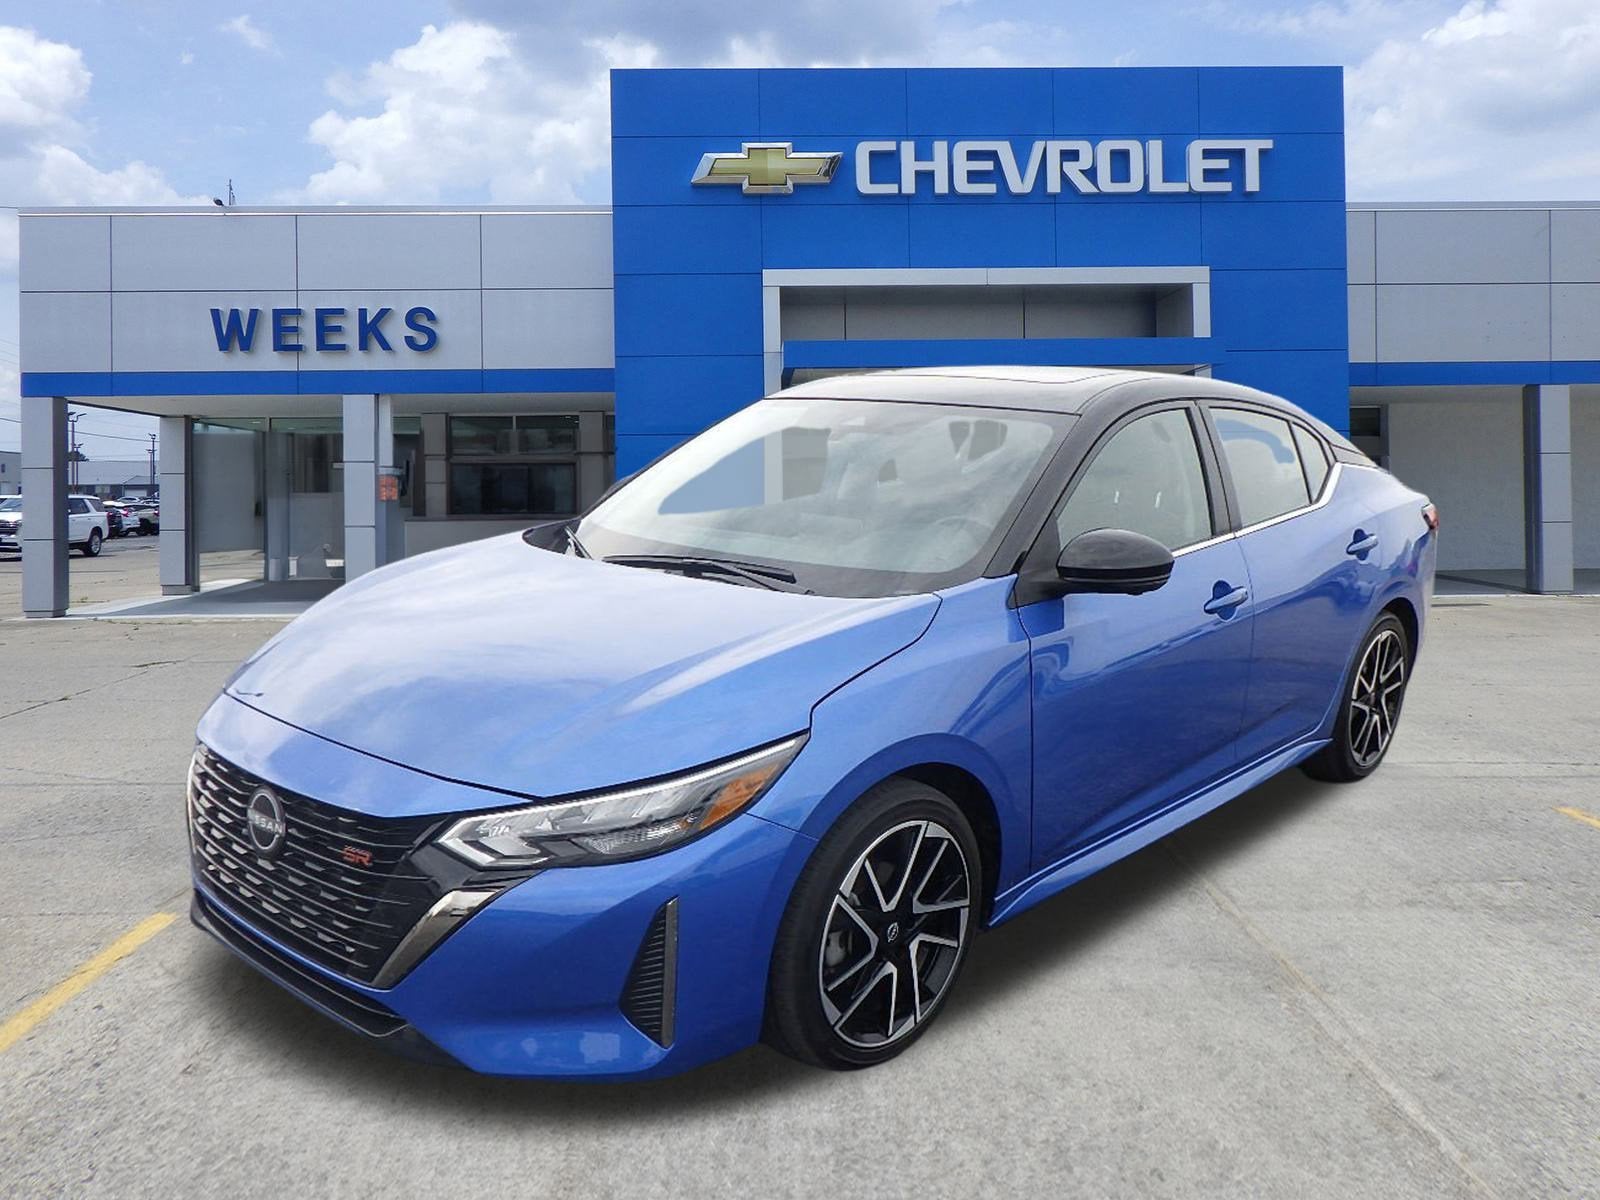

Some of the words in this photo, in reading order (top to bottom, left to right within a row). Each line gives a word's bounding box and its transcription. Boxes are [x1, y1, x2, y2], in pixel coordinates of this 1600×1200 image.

[855, 139, 1274, 194] CHEVROLET
[209, 306, 438, 352] WEEKS
[342, 845, 373, 867] SR
